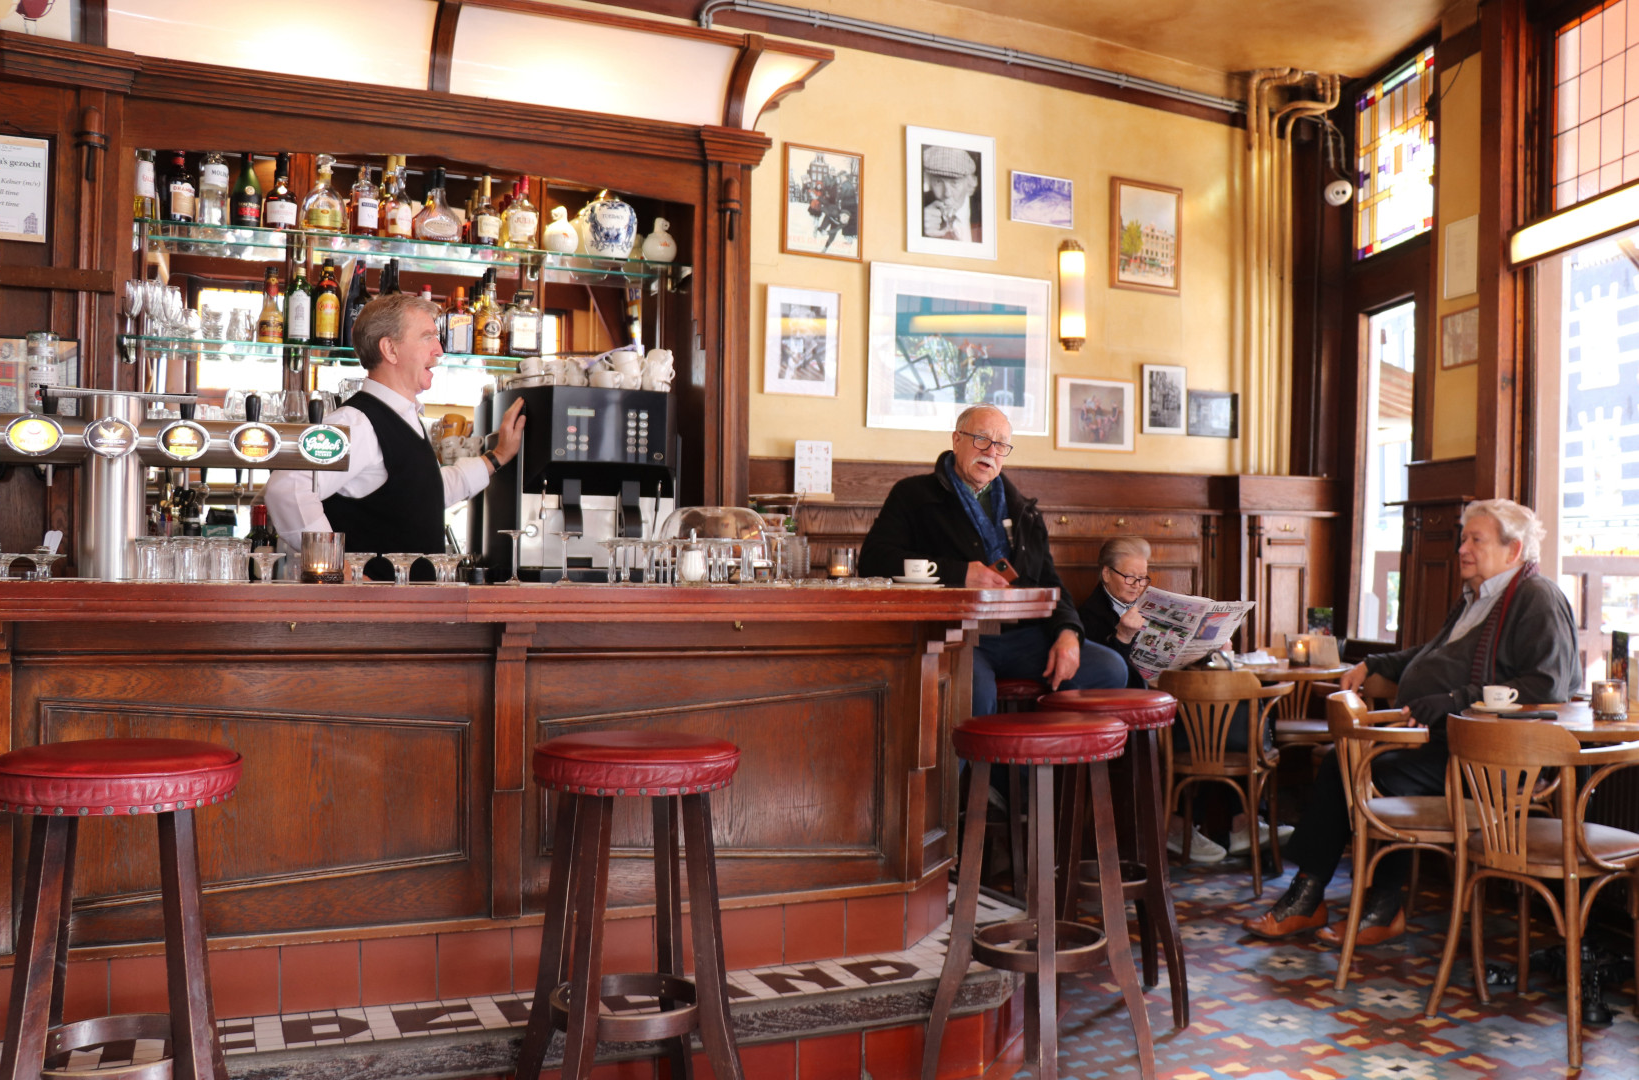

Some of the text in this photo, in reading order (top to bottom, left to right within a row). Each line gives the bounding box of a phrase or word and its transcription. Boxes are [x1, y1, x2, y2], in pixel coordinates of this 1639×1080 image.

[9, 160, 41, 168] gezocht
[22, 179, 41, 187] (m/v)
[305, 437, 342, 451] Grolsch
